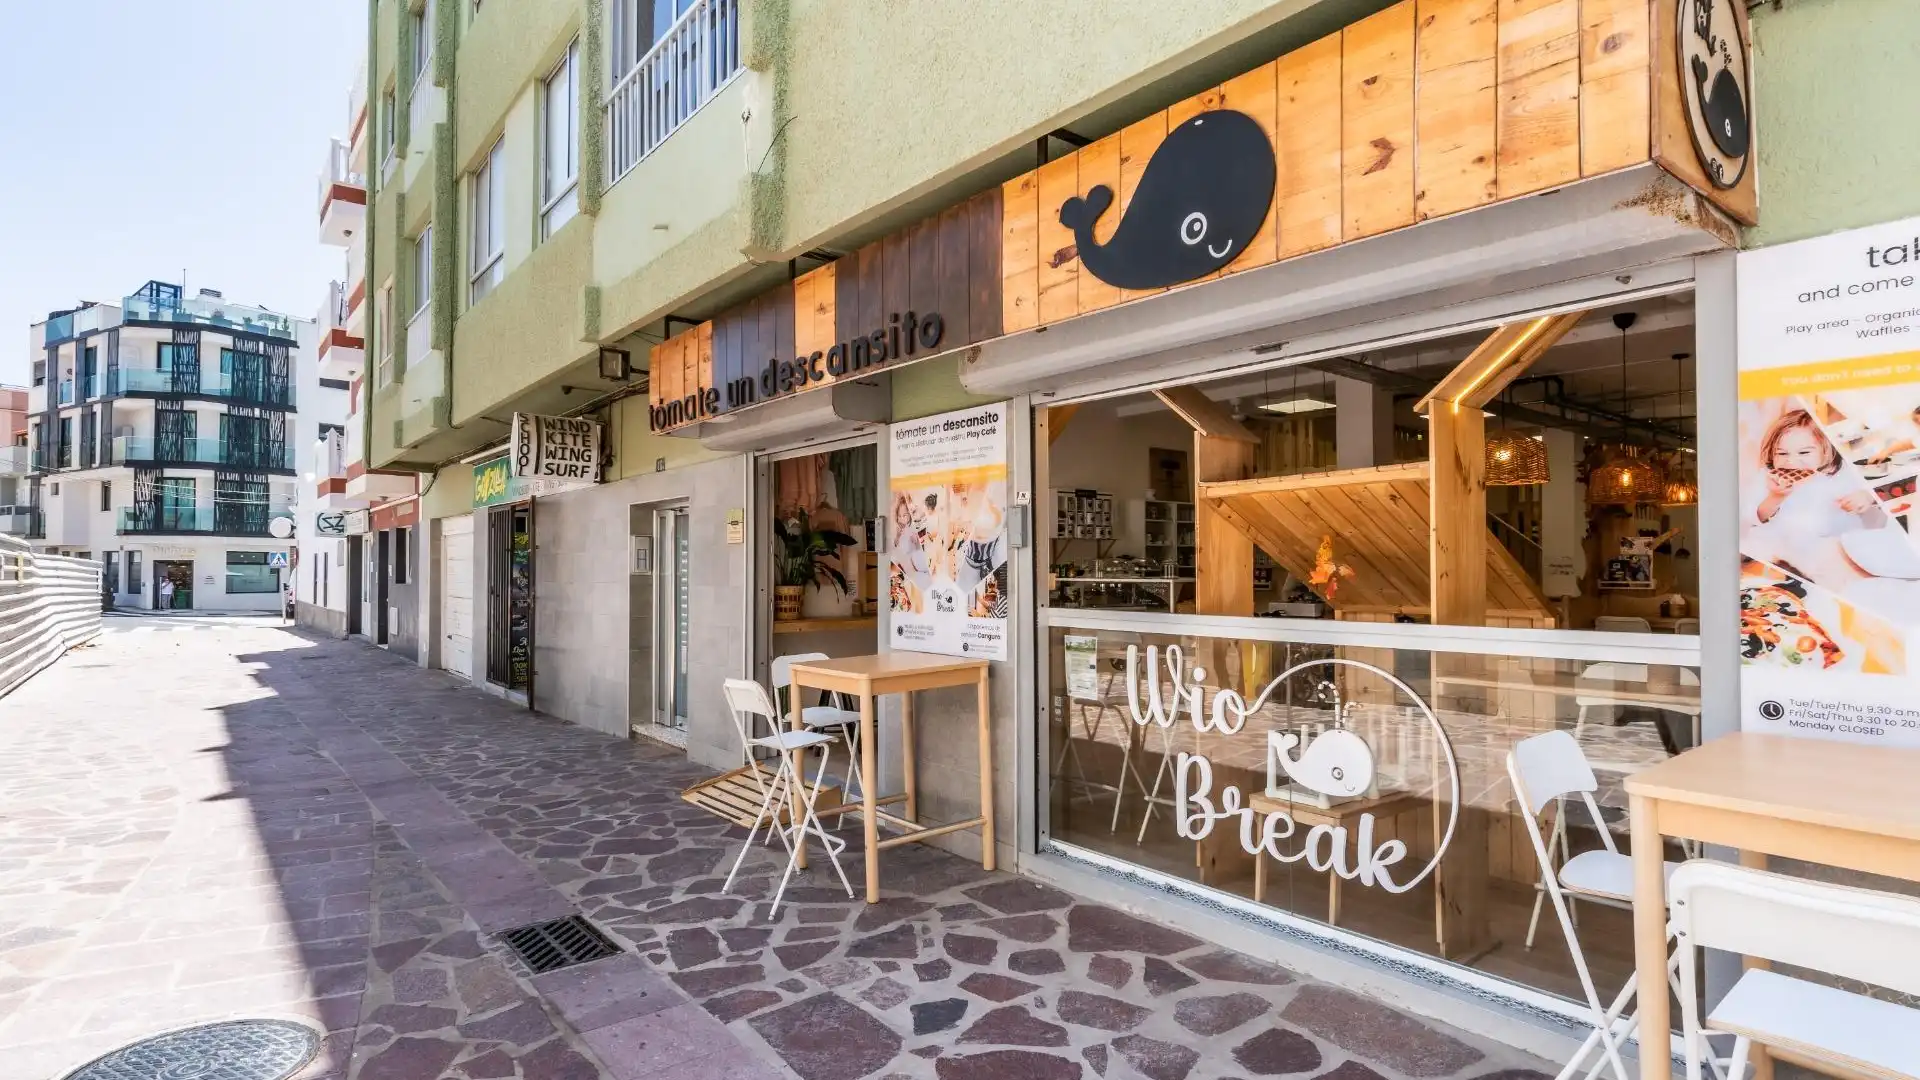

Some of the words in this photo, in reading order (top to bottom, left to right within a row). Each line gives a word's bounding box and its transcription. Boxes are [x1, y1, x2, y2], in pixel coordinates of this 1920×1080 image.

[1798, 285, 1840, 303] and
[1847, 275, 1914, 295] come
[1786, 324, 1812, 334] Play
[1817, 319, 1849, 330] area
[1856, 324, 1910, 339] Waffles
[648, 386, 721, 432] tómate
[727, 376, 754, 408] un
[760, 310, 945, 397] descansito
[544, 417, 591, 433] WIND
[930, 424, 941, 435] un
[943, 412, 999, 432] descansito
[518, 412, 530, 476] SCHOOL
[545, 431, 591, 447] KITE
[967, 431, 980, 440] Play
[545, 445, 592, 462] WING
[543, 462, 590, 478] SURF
[1127, 644, 1247, 735] Wio
[1789, 719, 1835, 732] Monday
[1838, 724, 1885, 736] CLOSED
[1885, 718, 1897, 727] to
[1176, 752, 1407, 893] Break
